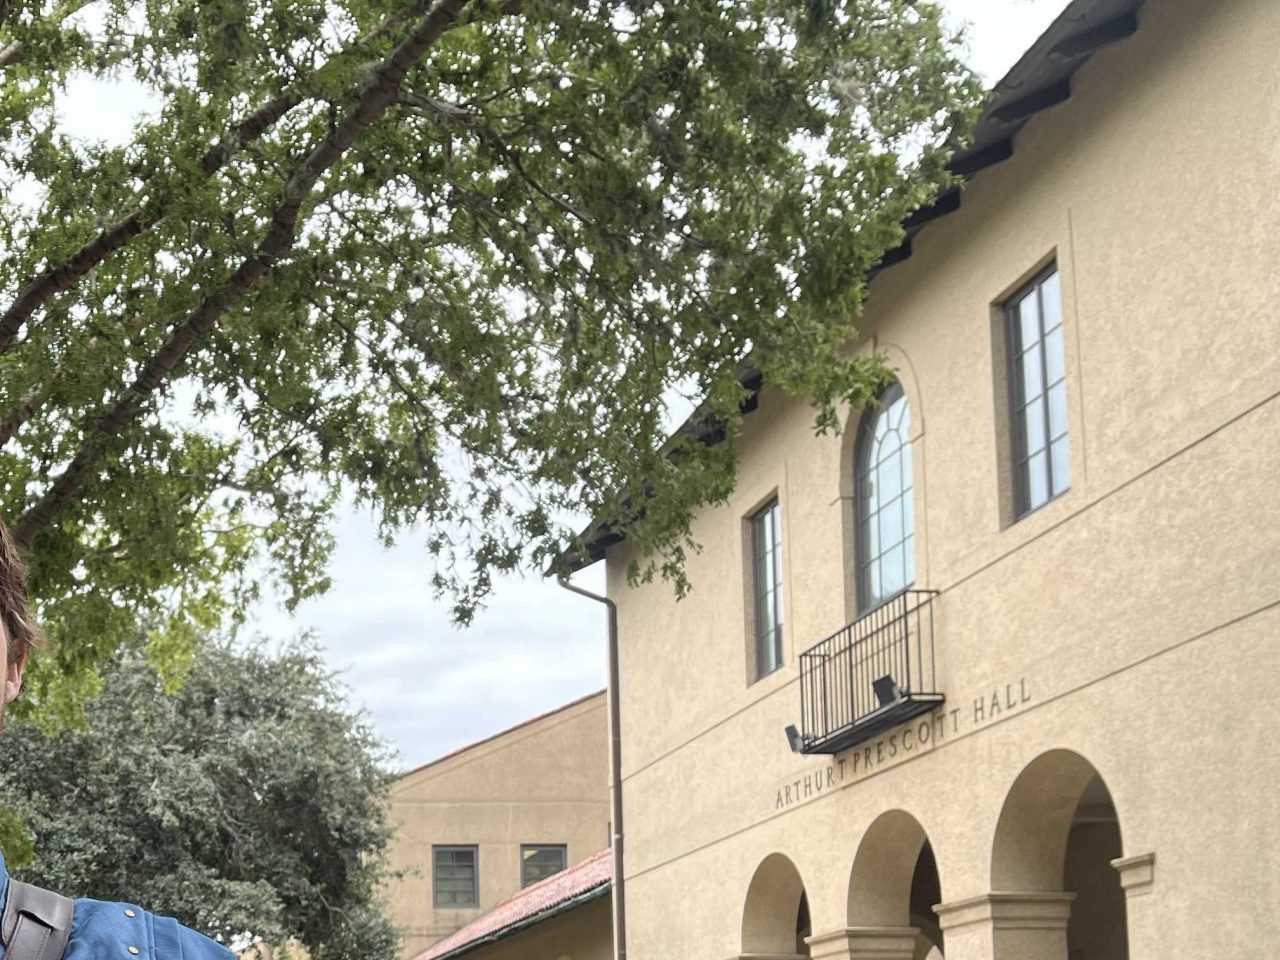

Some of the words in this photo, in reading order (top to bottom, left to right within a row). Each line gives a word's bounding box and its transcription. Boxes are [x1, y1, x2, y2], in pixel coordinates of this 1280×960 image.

[776, 766, 835, 809] ARTHUR
[852, 708, 961, 774] PRESCOTT
[973, 678, 1032, 724] HALL
